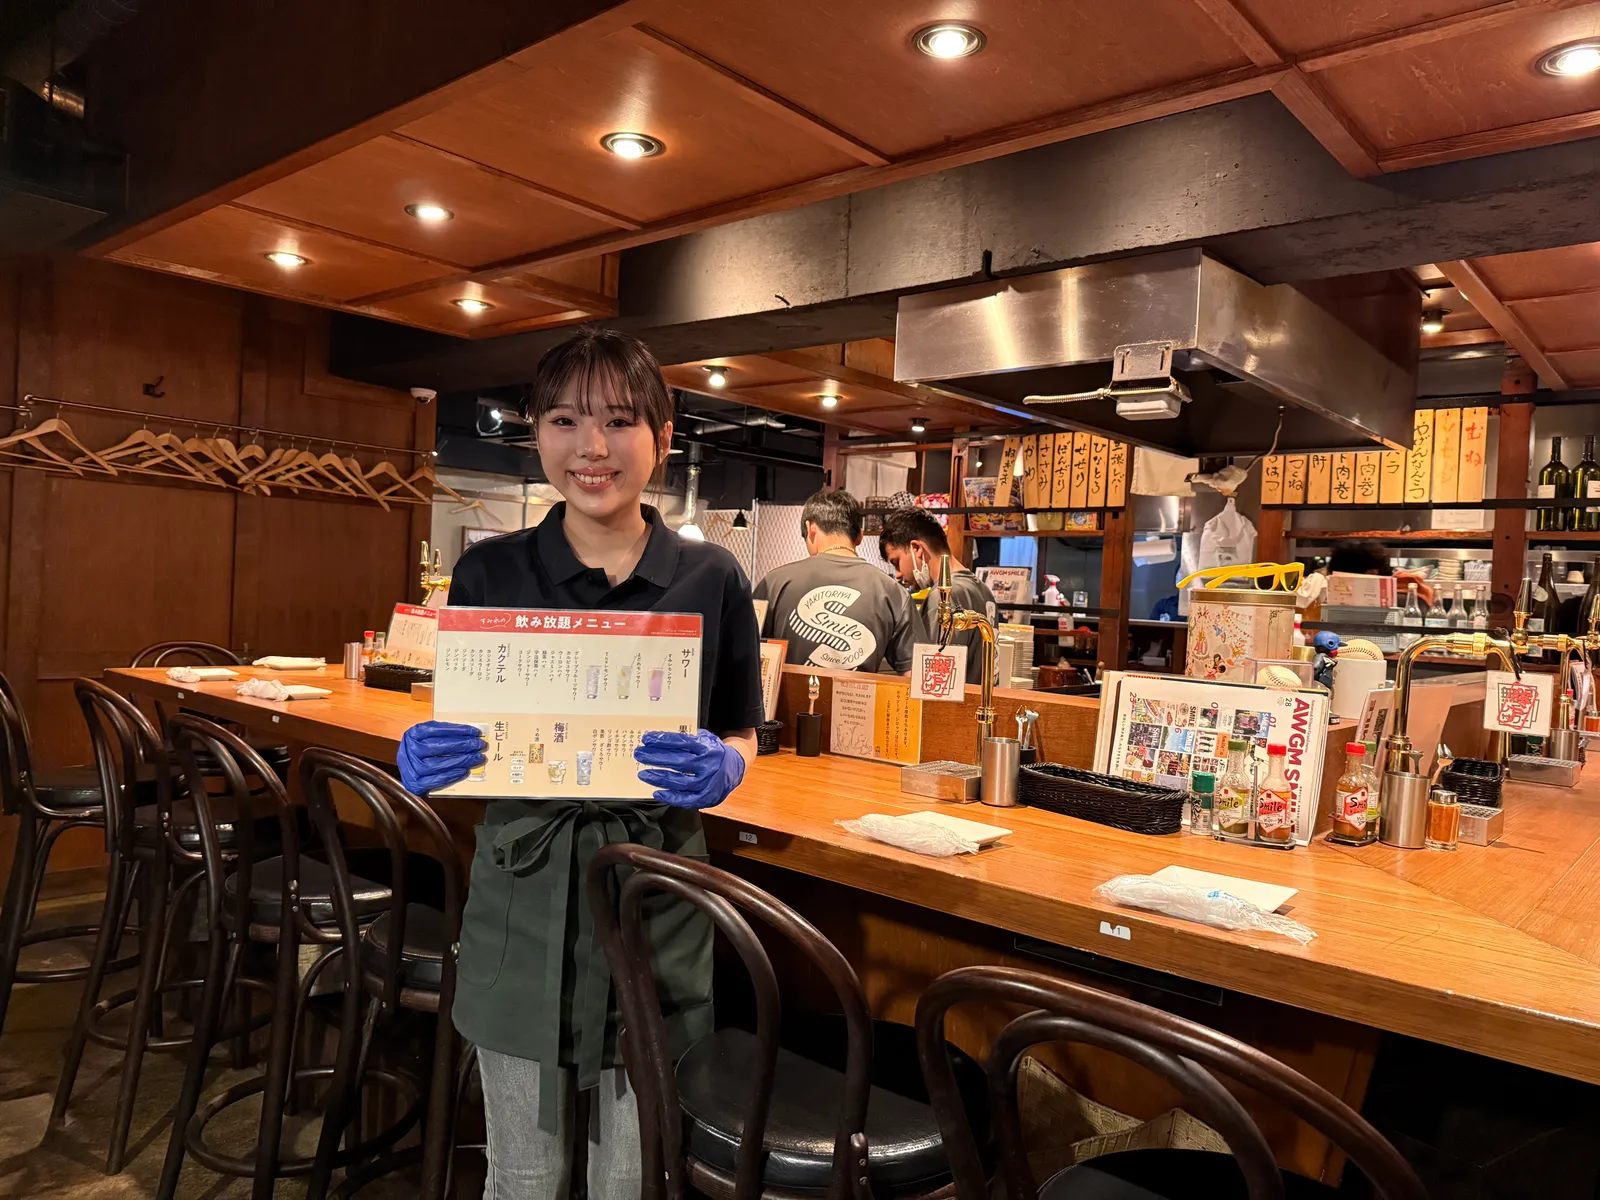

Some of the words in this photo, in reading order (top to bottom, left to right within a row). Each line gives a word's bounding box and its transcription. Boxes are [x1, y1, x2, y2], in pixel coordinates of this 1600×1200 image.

[1465, 422, 1484, 467] むね
[1024, 445, 1036, 481] かわ
[1039, 444, 1050, 490] ささみ
[1289, 460, 1304, 490] つくね
[1358, 452, 1376, 496] ー肉巻
[804, 590, 852, 609] YAKITORIYA
[515, 614, 626, 629] 飲み放題メニュー
[810, 612, 862, 640] Smile
[496, 644, 506, 683] カクテル
[682, 649, 690, 678] サワー
[820, 652, 840, 664] Since
[842, 648, 864, 664] 2009
[1285, 698, 1292, 706] 28
[1188, 706, 1196, 727] SMILE
[493, 720, 504, 762] 生ビール
[554, 722, 564, 743] 梅酒
[1287, 698, 1310, 764] AWGM
[1219, 797, 1239, 808] mile
[746, 834, 752, 842] 12
